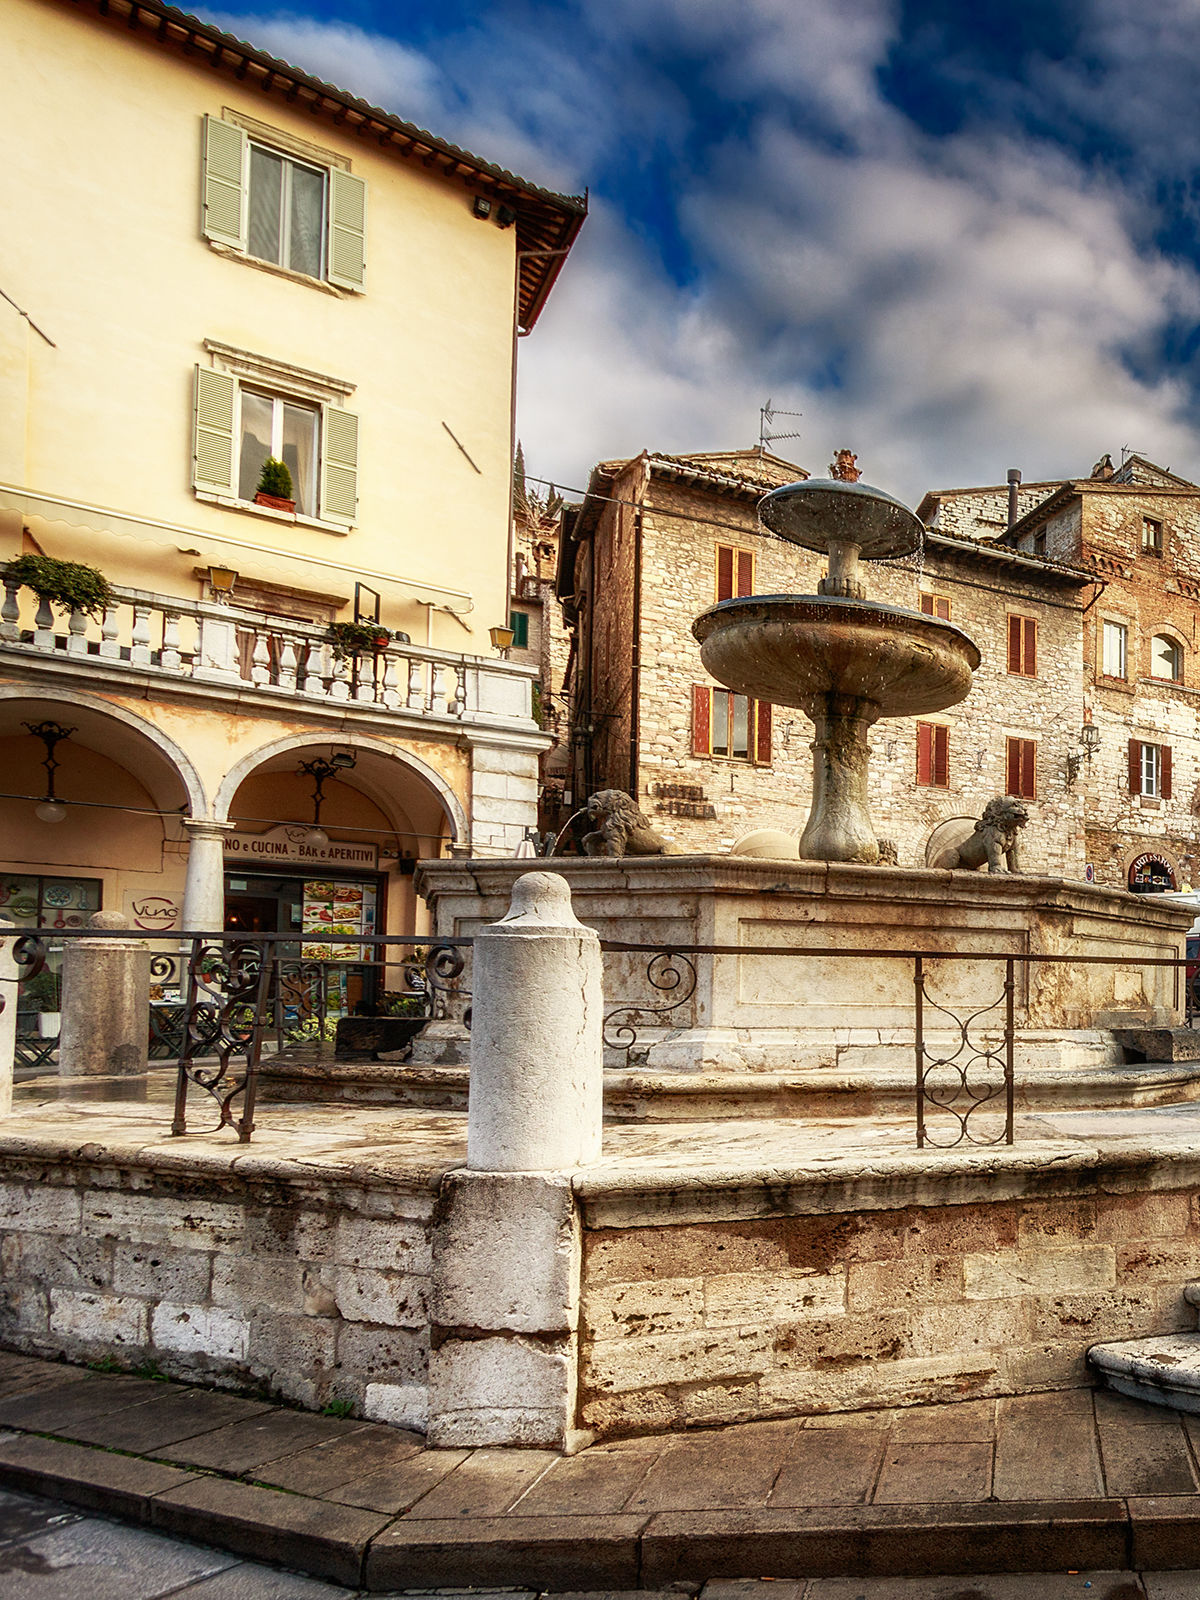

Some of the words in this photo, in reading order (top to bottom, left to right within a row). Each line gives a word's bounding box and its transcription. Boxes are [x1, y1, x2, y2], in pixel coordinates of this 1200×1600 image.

[656, 783, 708, 801] HOTEL
[251, 840, 288, 855] CUCINA
[328, 847, 373, 861] APERITIVI
